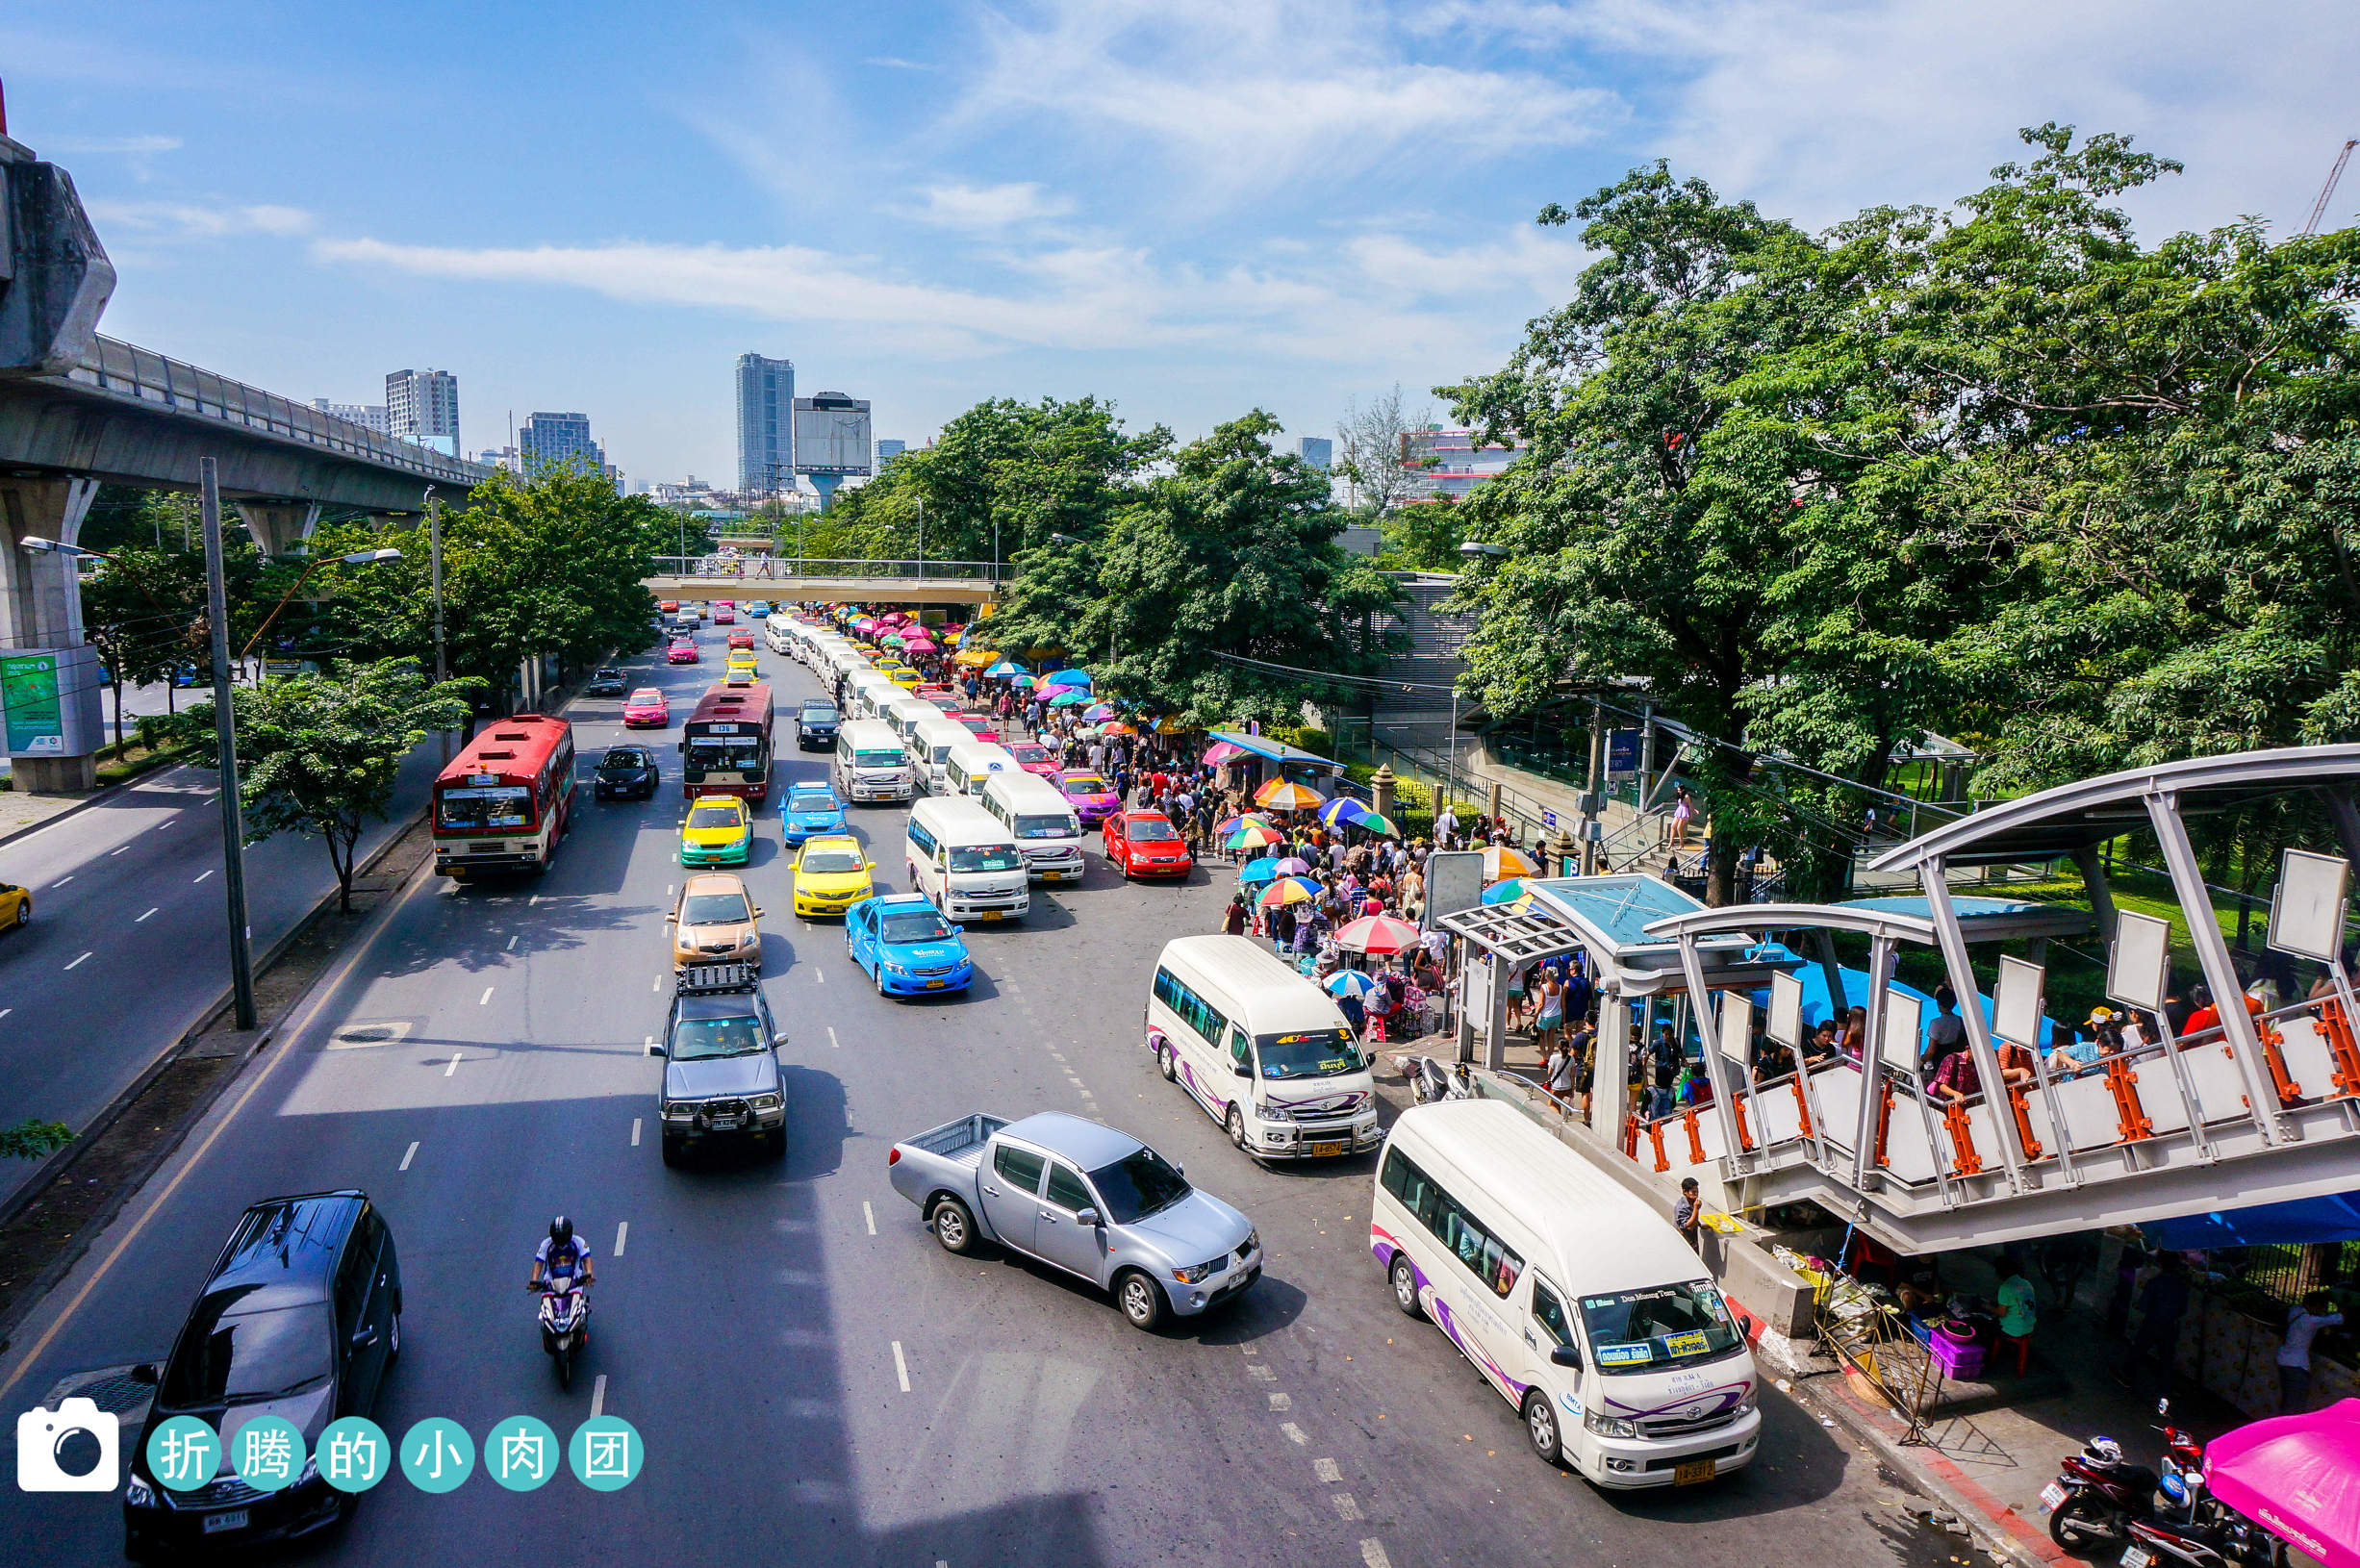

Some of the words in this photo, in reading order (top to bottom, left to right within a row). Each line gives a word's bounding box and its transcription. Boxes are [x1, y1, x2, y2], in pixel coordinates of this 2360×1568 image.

[1620, 1295, 1636, 1303] Don
[1602, 1349, 1630, 1362] ดอนเมือง
[1631, 1348, 1649, 1360] รังสิต
